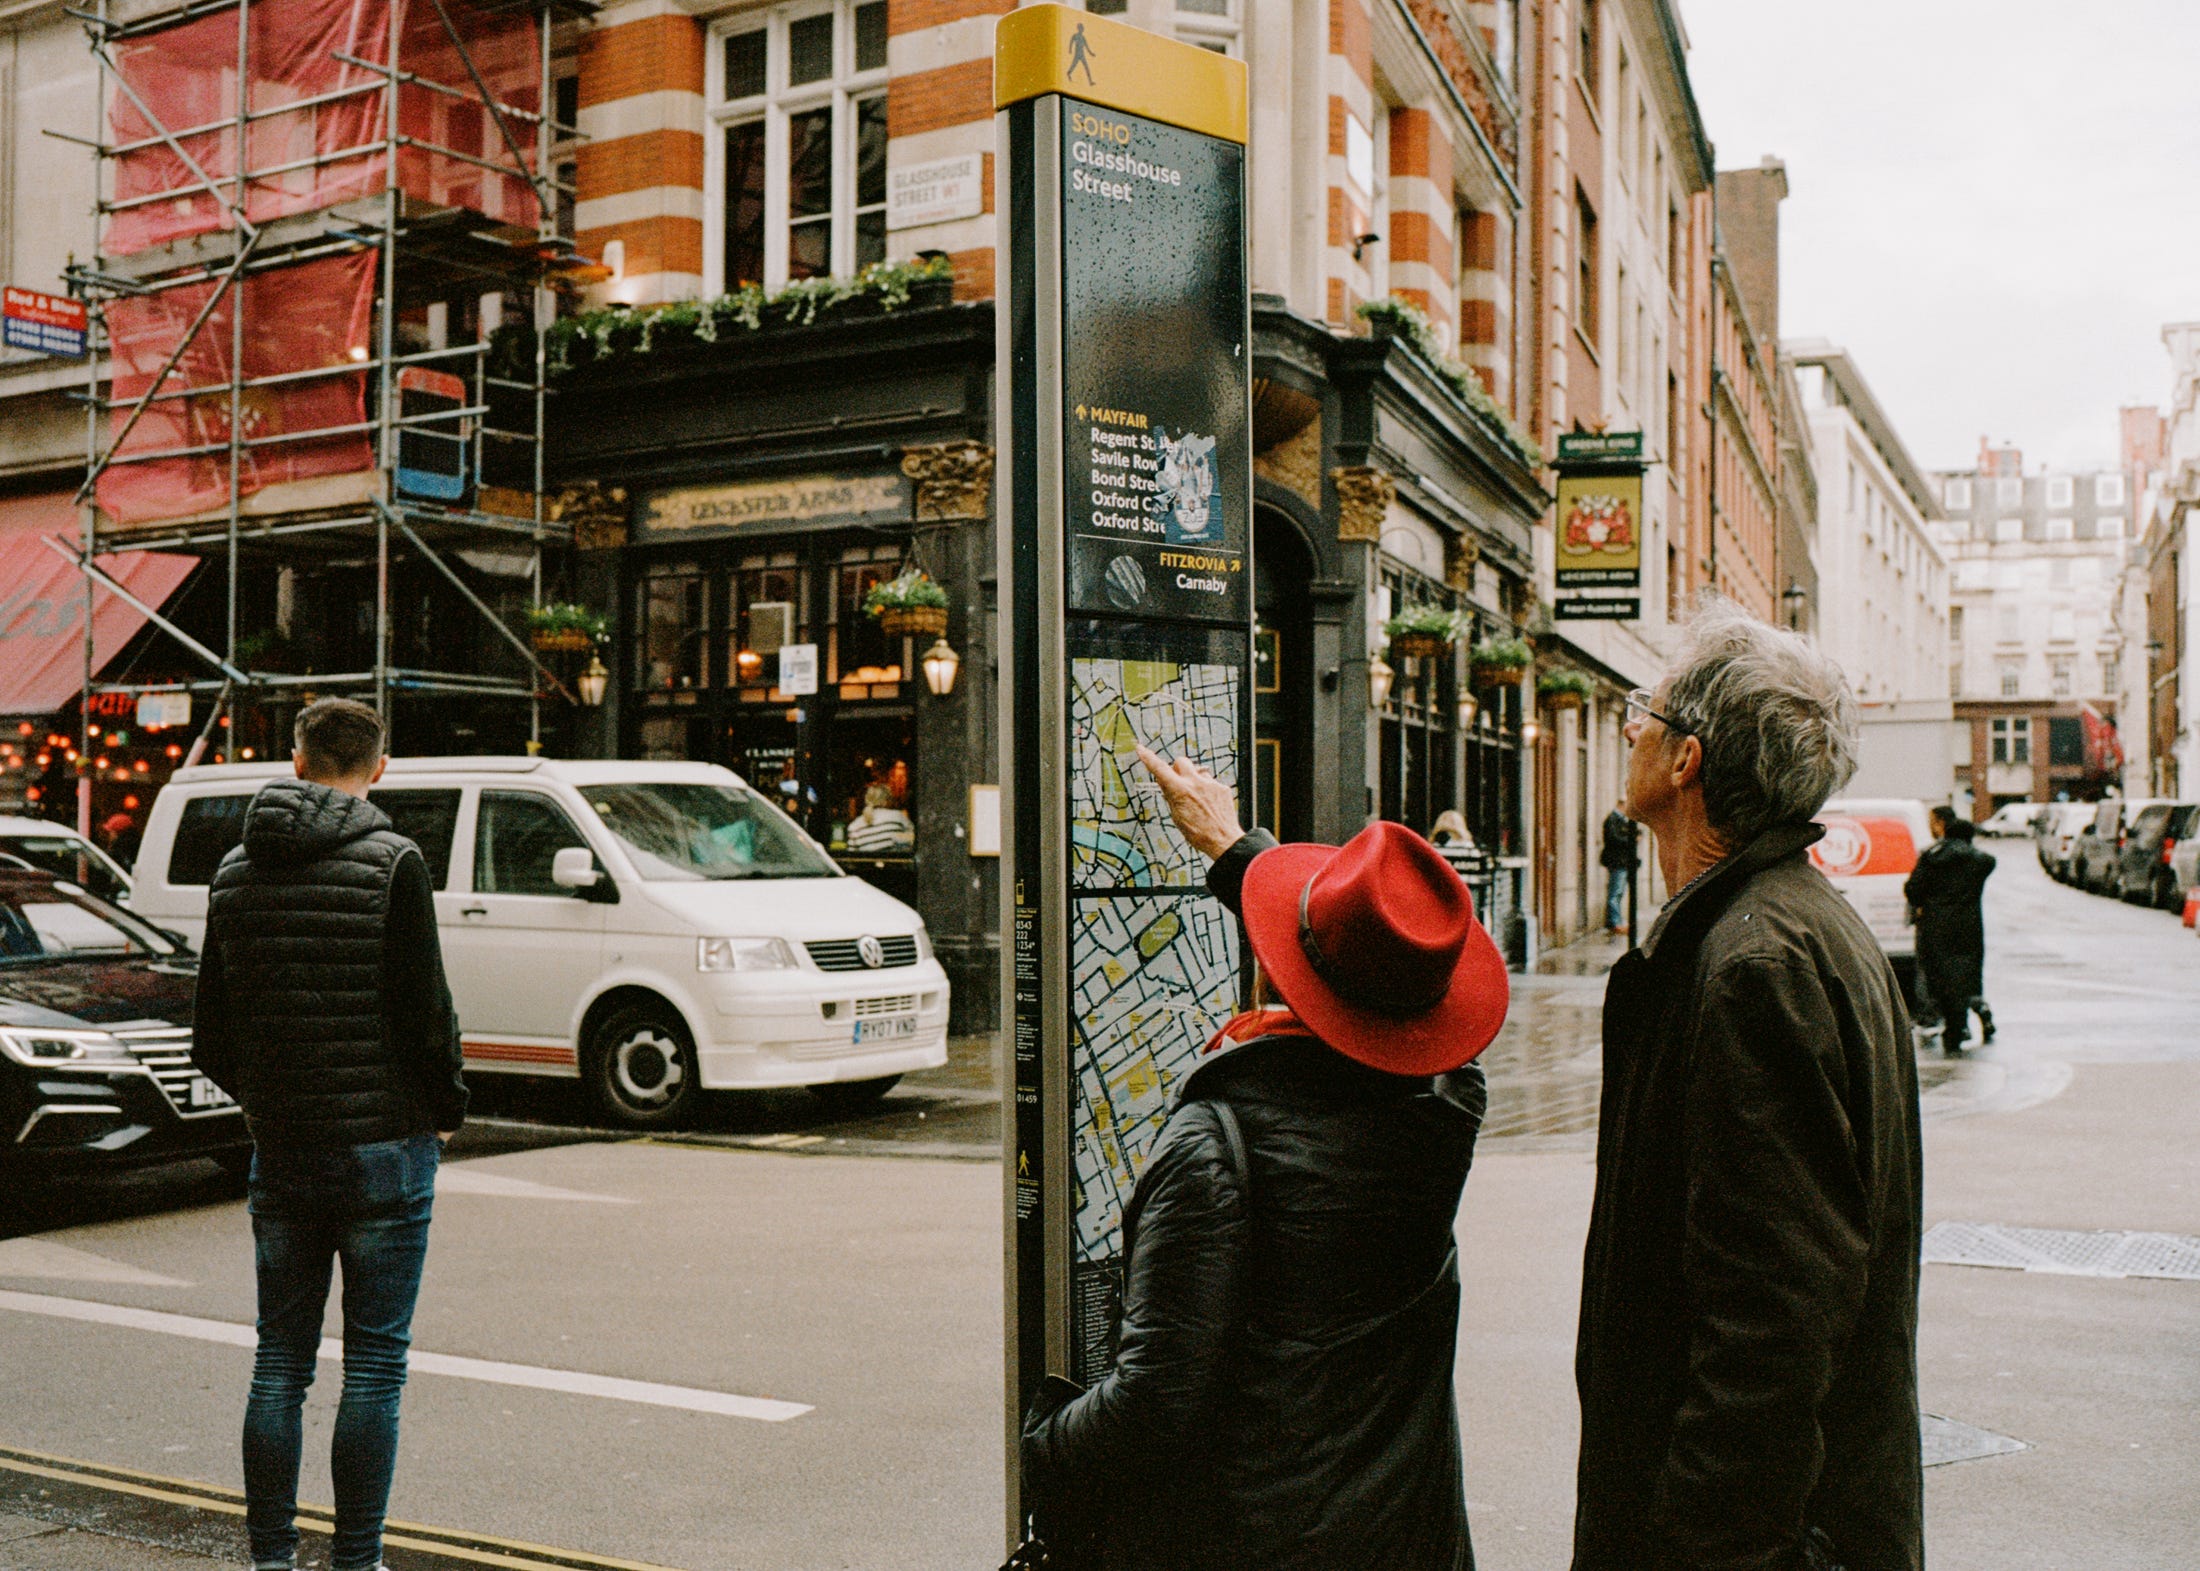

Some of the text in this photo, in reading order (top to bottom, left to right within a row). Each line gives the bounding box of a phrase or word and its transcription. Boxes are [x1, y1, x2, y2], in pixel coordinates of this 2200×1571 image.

[1072, 112, 1130, 145] SOHO
[1072, 141, 1181, 186] Glasshouse
[895, 160, 970, 189] GLASSHOUSE
[895, 185, 936, 208] STREET
[1072, 169, 1133, 203] Street
[1091, 407, 1148, 429] MAYFAIR
[1091, 427, 1138, 448] Regent
[1091, 449, 1130, 468] Savile
[1091, 469, 1126, 489] Bond
[1091, 490, 1139, 511] Oxford
[1091, 511, 1139, 531] Oxford
[1159, 552, 1227, 572] FITZROVIA
[1176, 573, 1227, 595] Carnaby
[1016, 920, 1033, 930] 0343
[1016, 930, 1028, 940] 222
[1017, 1093, 1038, 1104] 01459
